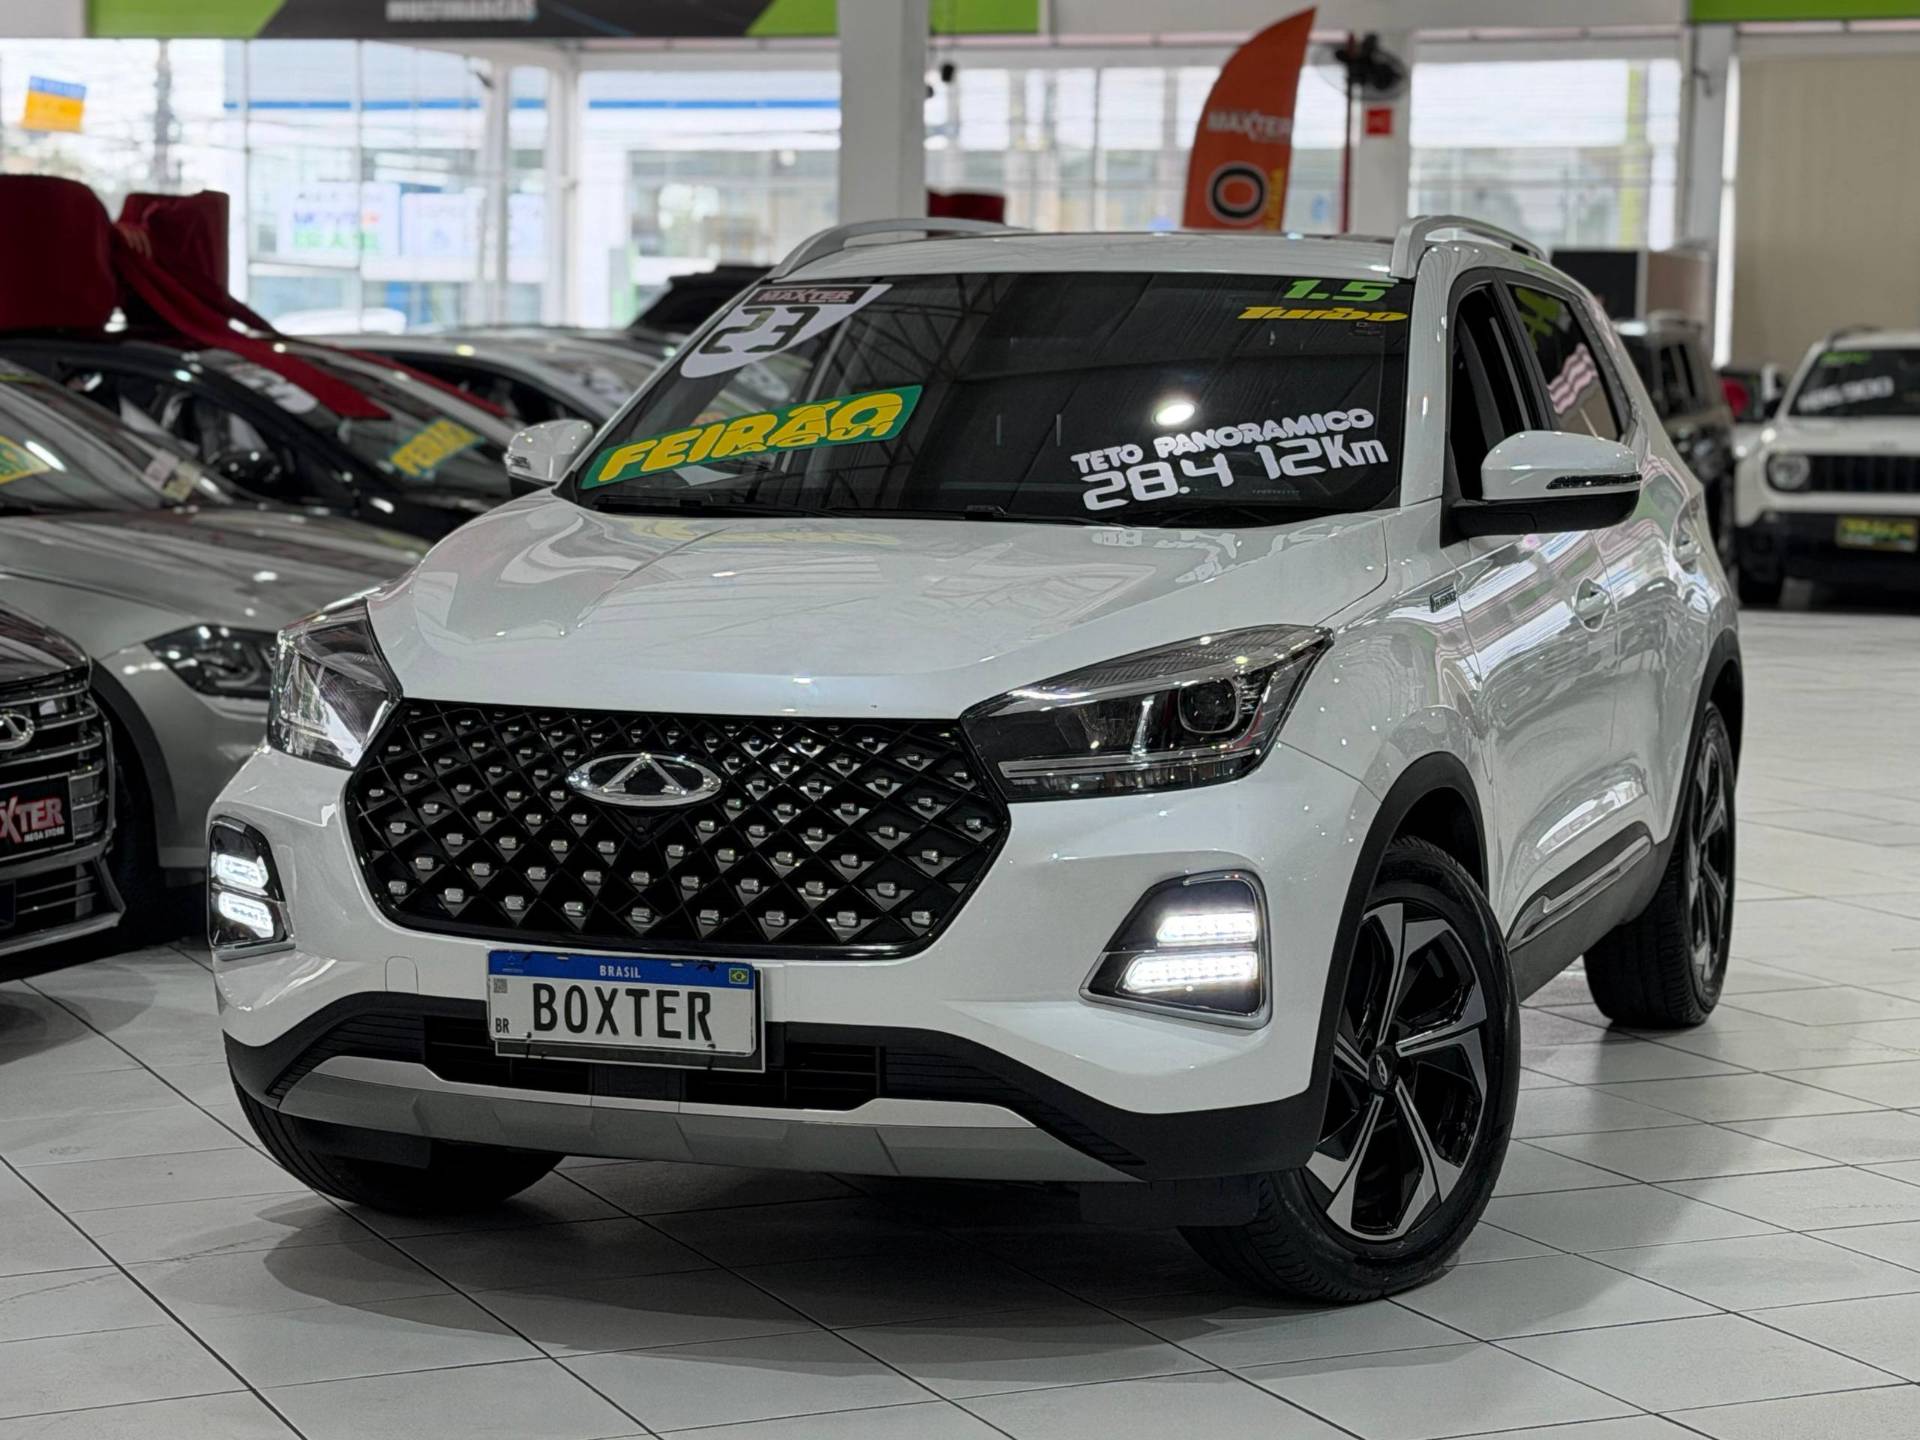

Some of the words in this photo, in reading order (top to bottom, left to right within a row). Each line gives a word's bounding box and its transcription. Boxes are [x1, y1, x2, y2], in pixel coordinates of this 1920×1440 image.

[758, 289, 855, 303] MAXTER
[1284, 279, 1396, 302] 1.5
[1237, 306, 1408, 321] Turbo
[698, 306, 820, 354] 23
[1070, 443, 1144, 474] TETO
[1153, 408, 1375, 460] PANORAMICO
[1080, 452, 1235, 511] 28.4
[599, 965, 641, 979] BRASIL
[532, 982, 713, 1041] BOXTER
[495, 1017, 510, 1034] BR
